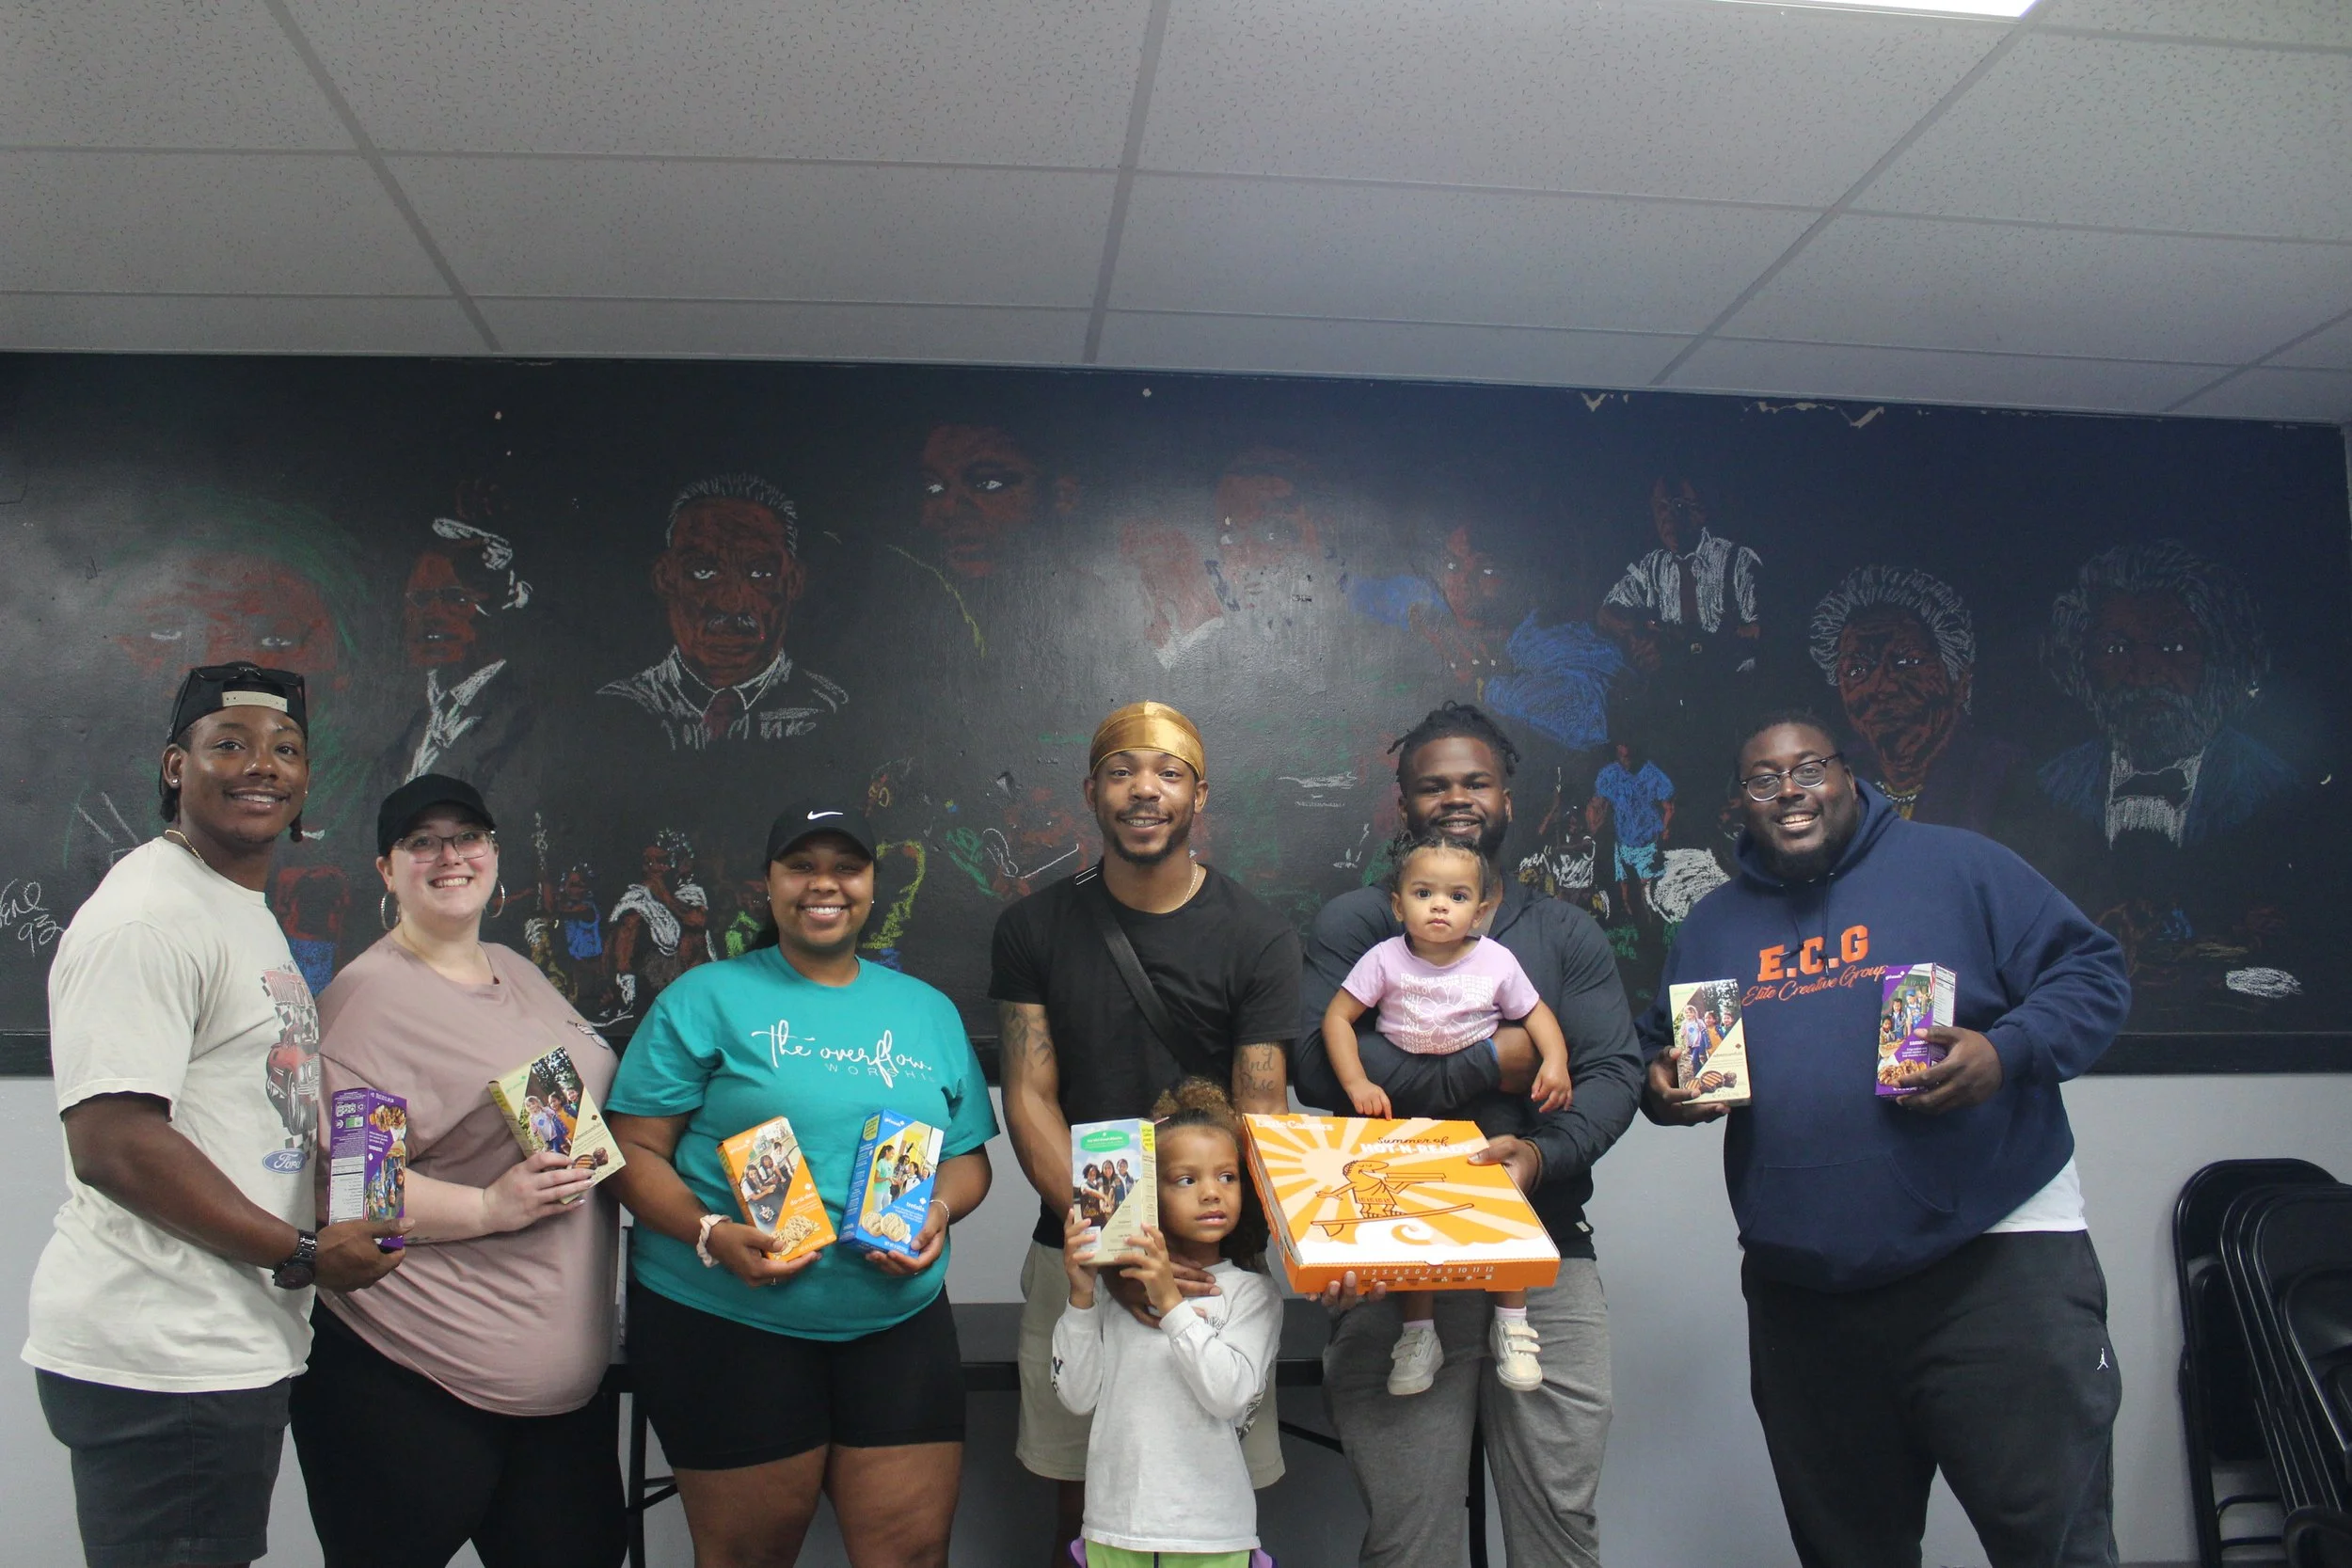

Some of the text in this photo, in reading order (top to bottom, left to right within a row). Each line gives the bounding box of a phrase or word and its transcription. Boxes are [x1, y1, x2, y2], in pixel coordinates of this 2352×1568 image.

[1757, 924, 1868, 982] E.C.G
[1400, 972, 1435, 985] FOLLOW
[1741, 964, 1889, 1006] Elite Creative Group
[1360, 1143, 1472, 1155] HOT-N-READY
[1433, 1136, 1449, 1147] of
[274, 1152, 302, 1169] Ford
